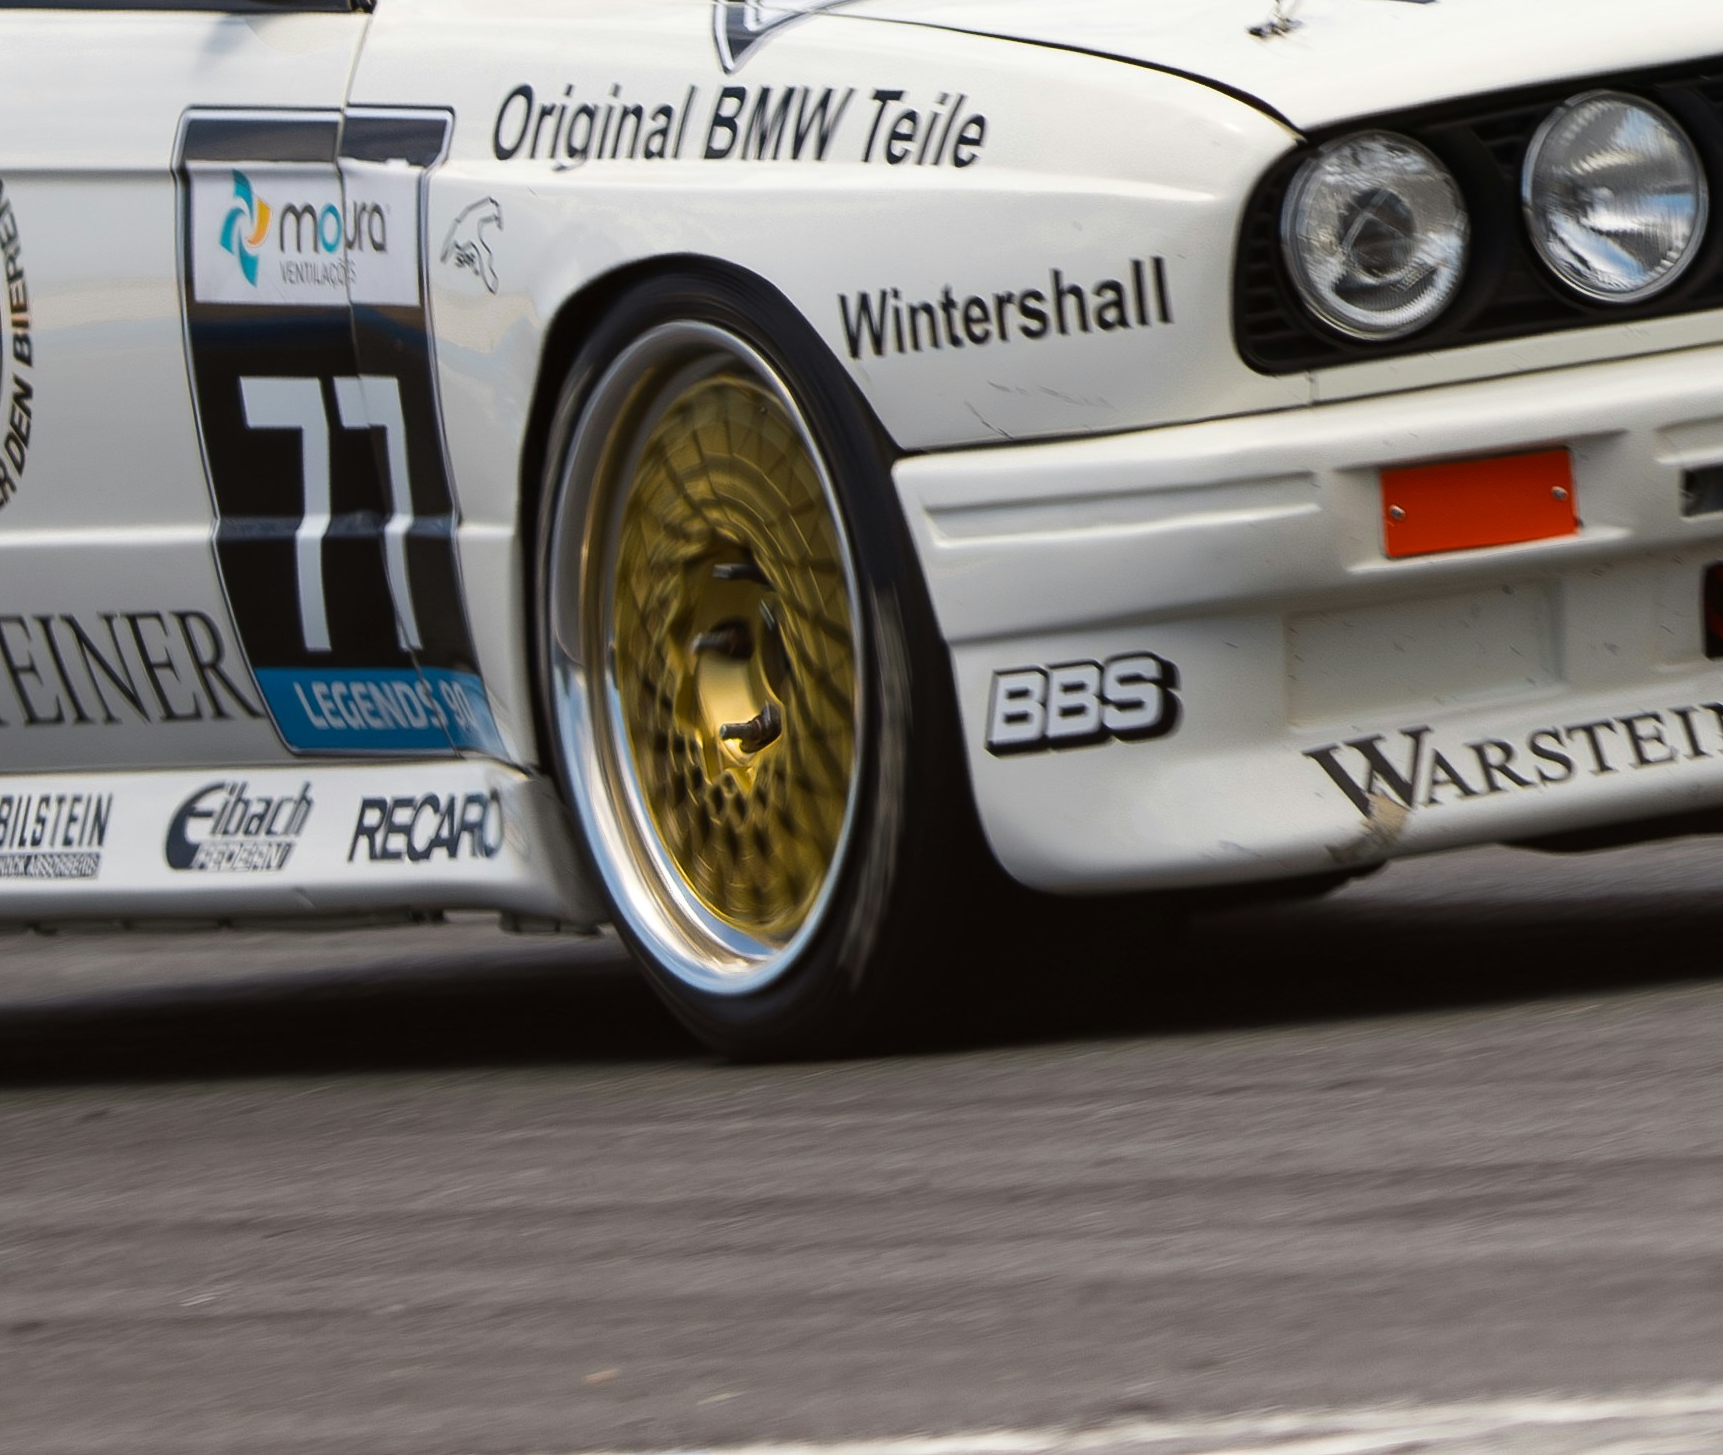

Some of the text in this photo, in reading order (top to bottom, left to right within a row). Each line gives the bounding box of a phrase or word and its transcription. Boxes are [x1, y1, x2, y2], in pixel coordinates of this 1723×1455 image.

[493, 83, 988, 171] Original BMW Teile
[279, 201, 387, 254] moura
[837, 256, 1175, 360] Wintershall
[3, 372, 34, 479] DEN
[238, 375, 424, 653] 77
[292, 679, 449, 731] LEGENDS
[984, 650, 1182, 758] BBS
[165, 779, 314, 871] Eibach
[347, 788, 505, 862] RECARO
